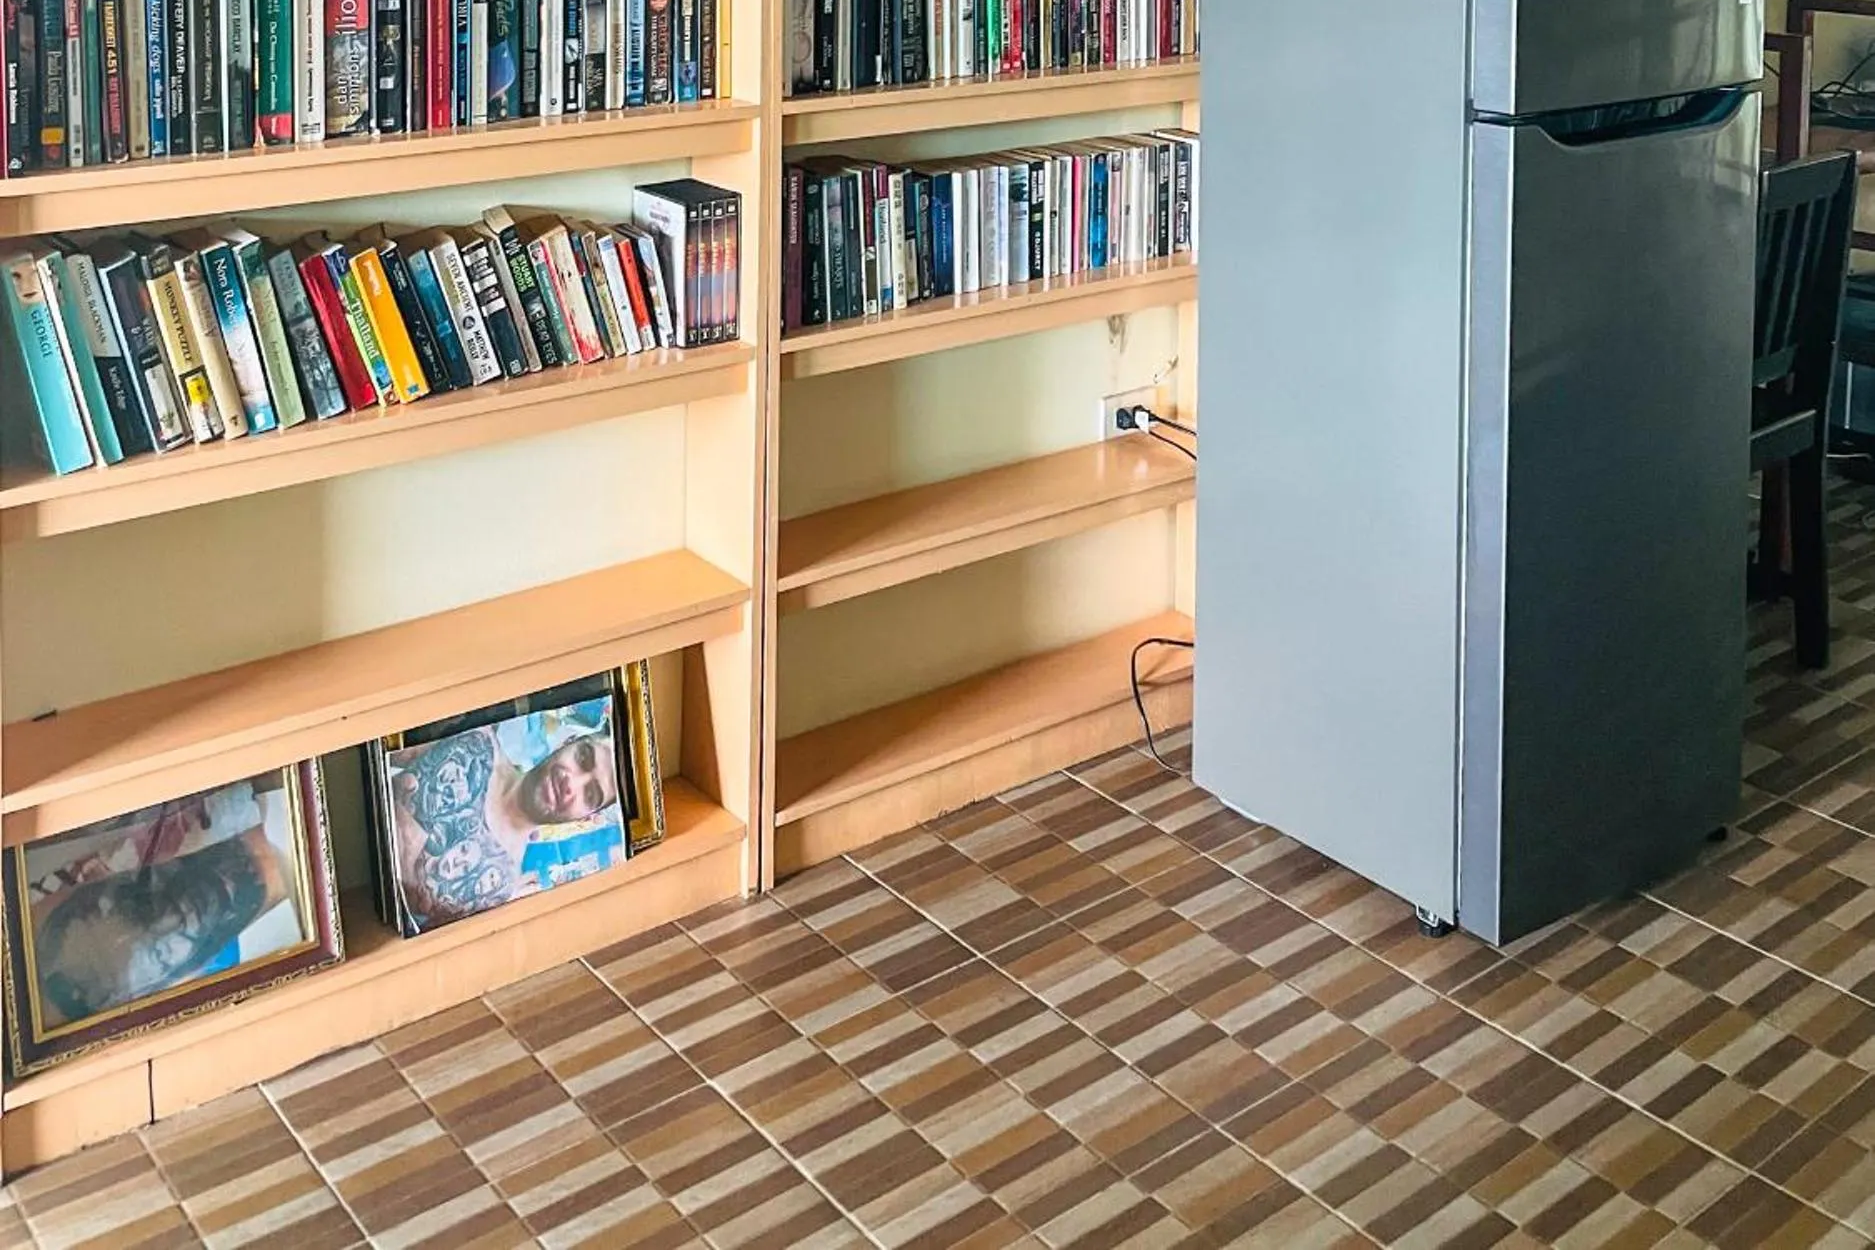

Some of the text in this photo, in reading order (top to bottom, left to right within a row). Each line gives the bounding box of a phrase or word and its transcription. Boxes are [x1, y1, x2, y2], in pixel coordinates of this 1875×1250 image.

[103, 0, 118, 74] FAHRENHEIT 451
[150, 0, 164, 42] kicking
[46, 51, 62, 75] Paula
[150, 44, 165, 74] dogs
[174, 30, 186, 74] DEAVER
[334, 75, 348, 105] dan
[348, 49, 361, 116] simmons
[214, 257, 229, 288] Nora
[446, 253, 463, 281] SEVEN
[509, 258, 527, 293] WOODS
[516, 254, 536, 289] STUART
[164, 280, 182, 325] MONKEY
[454, 280, 475, 313] ANCIENT
[30, 309, 53, 358] GEORGE
[87, 299, 106, 345] BLACKMAN
[350, 298, 378, 360] Thailand
[473, 329, 490, 361] MATTHEW
[533, 319, 558, 365] DEAD EYES
